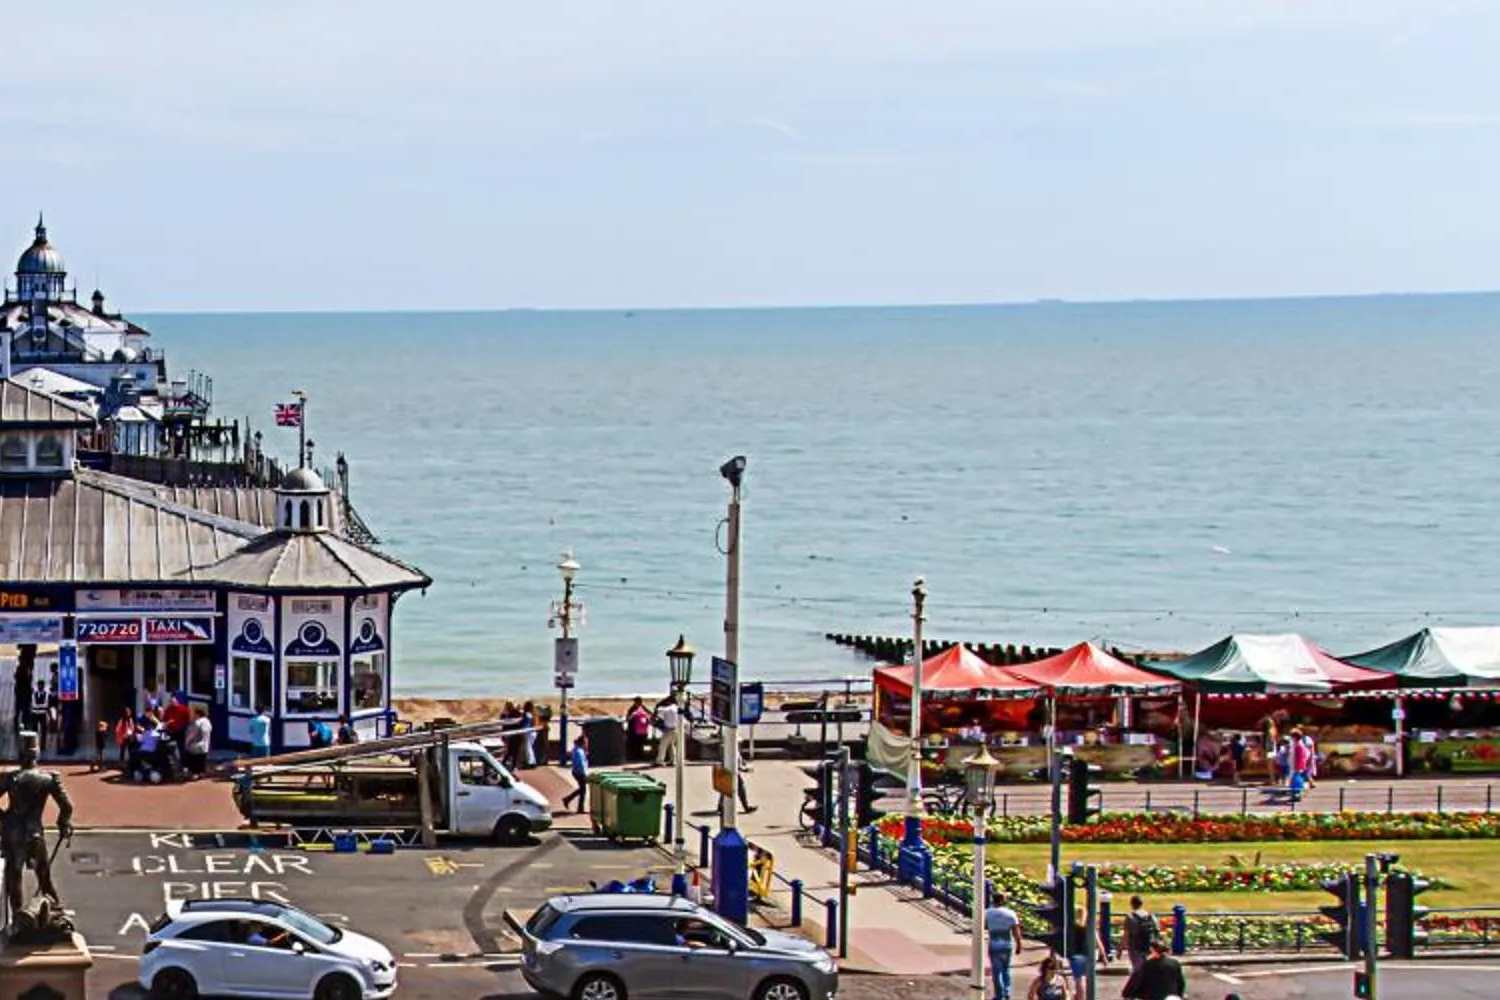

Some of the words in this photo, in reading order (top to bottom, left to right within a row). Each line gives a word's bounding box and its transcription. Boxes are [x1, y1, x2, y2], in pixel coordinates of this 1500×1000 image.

[78, 623, 139, 636] 720720
[147, 619, 181, 632] TAXI
[131, 854, 316, 875] CLEAR
[163, 881, 291, 902] PIER
